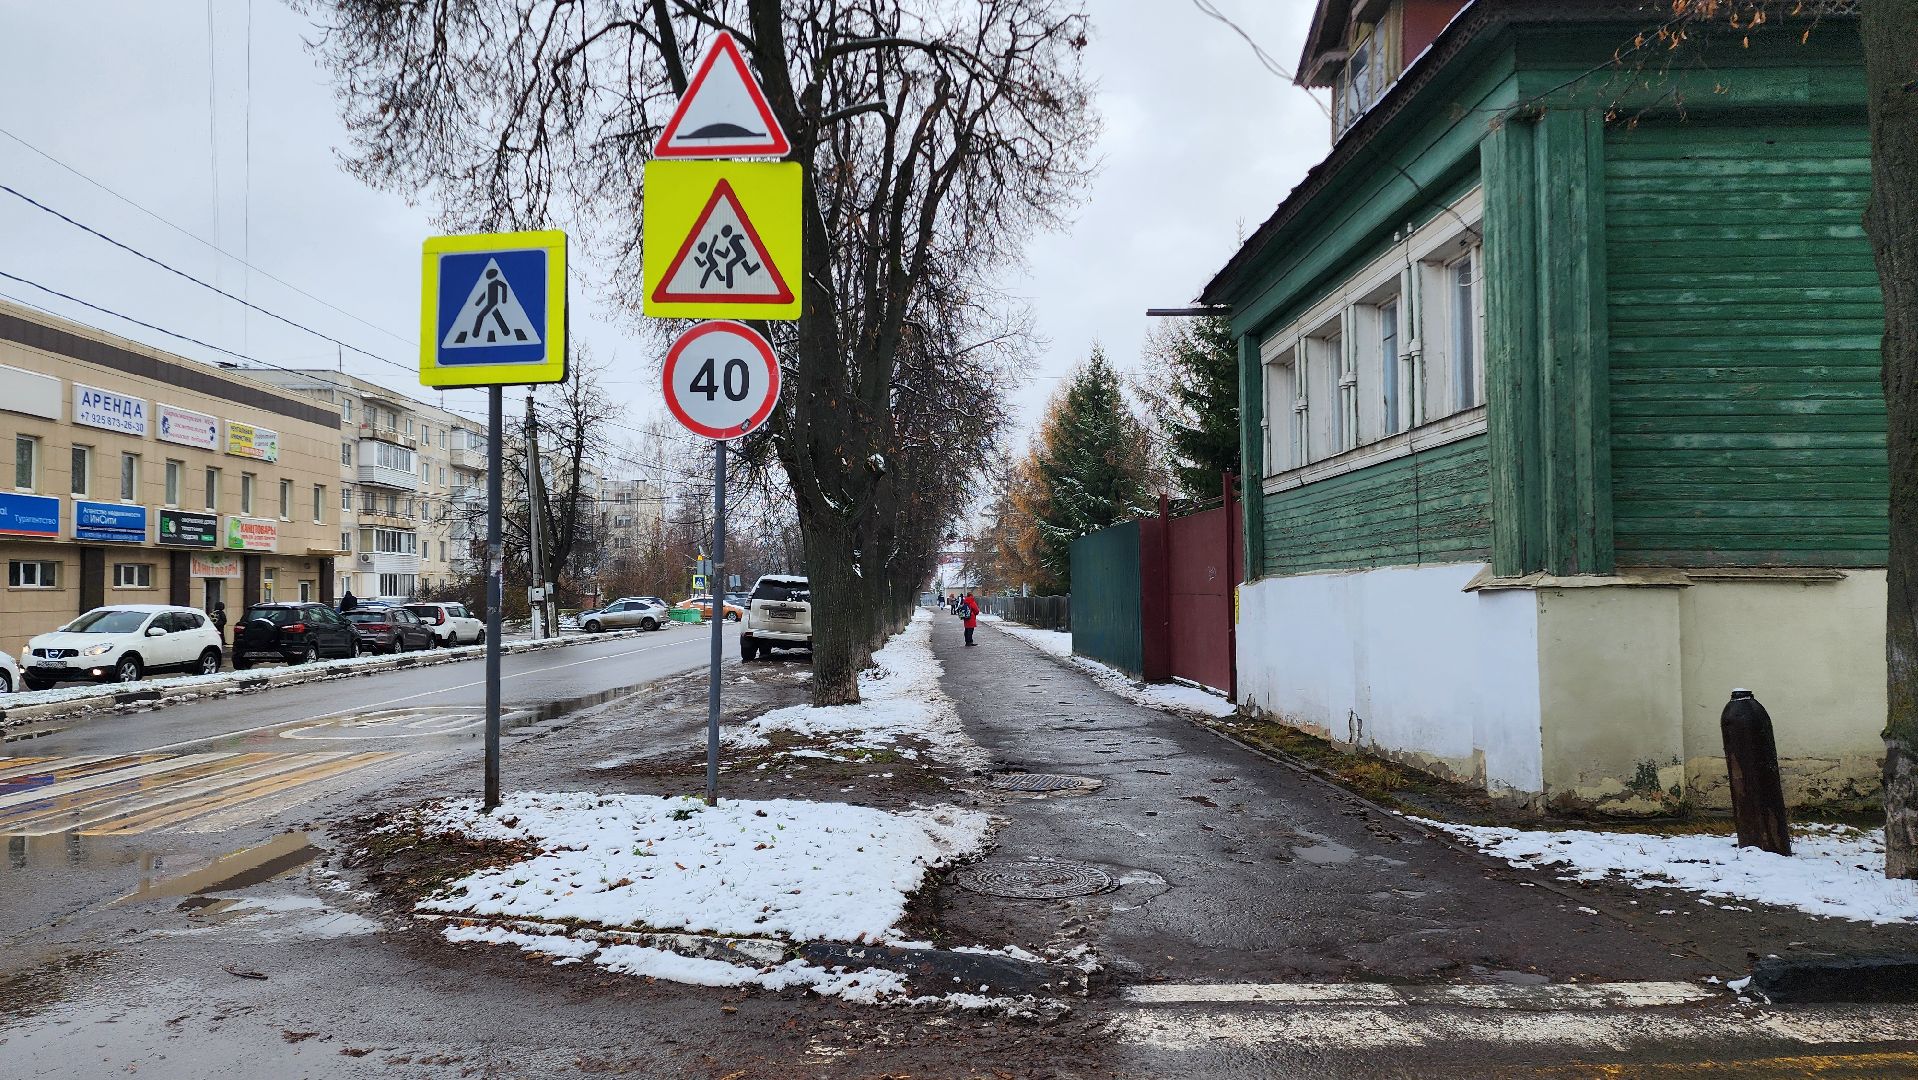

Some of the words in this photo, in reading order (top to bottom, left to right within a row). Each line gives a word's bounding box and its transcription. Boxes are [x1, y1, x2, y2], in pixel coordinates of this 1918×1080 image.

[690, 358, 750, 401] 40
[82, 391, 142, 419] АРЕНДА
[14, 514, 57, 525] Турагентство
[240, 523, 277, 535] КАНЦТОВАРЫ
